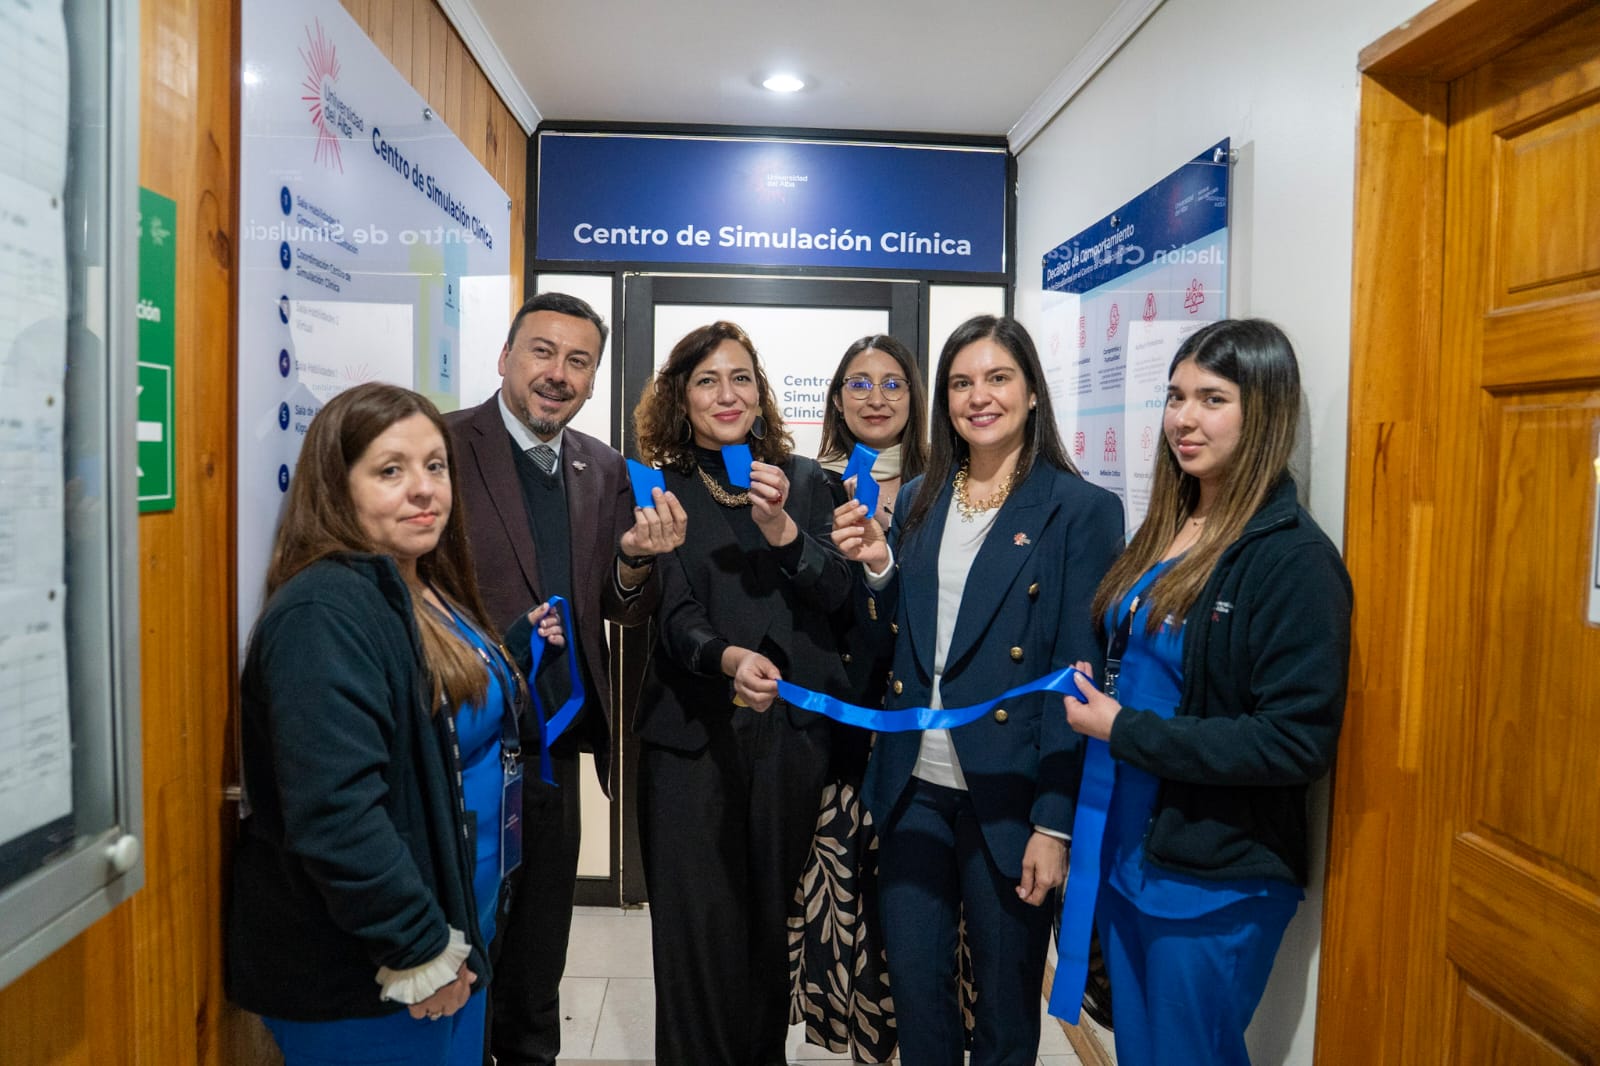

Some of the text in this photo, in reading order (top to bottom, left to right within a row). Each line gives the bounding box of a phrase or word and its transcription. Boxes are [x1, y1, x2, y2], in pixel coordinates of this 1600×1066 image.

[372, 127, 493, 250] Centro de Simulación Clínica
[573, 223, 971, 256] Centro de Simulación Clínica
[783, 375, 832, 387] Centro
[783, 390, 825, 402] Simul
[783, 406, 824, 418] Clínic
